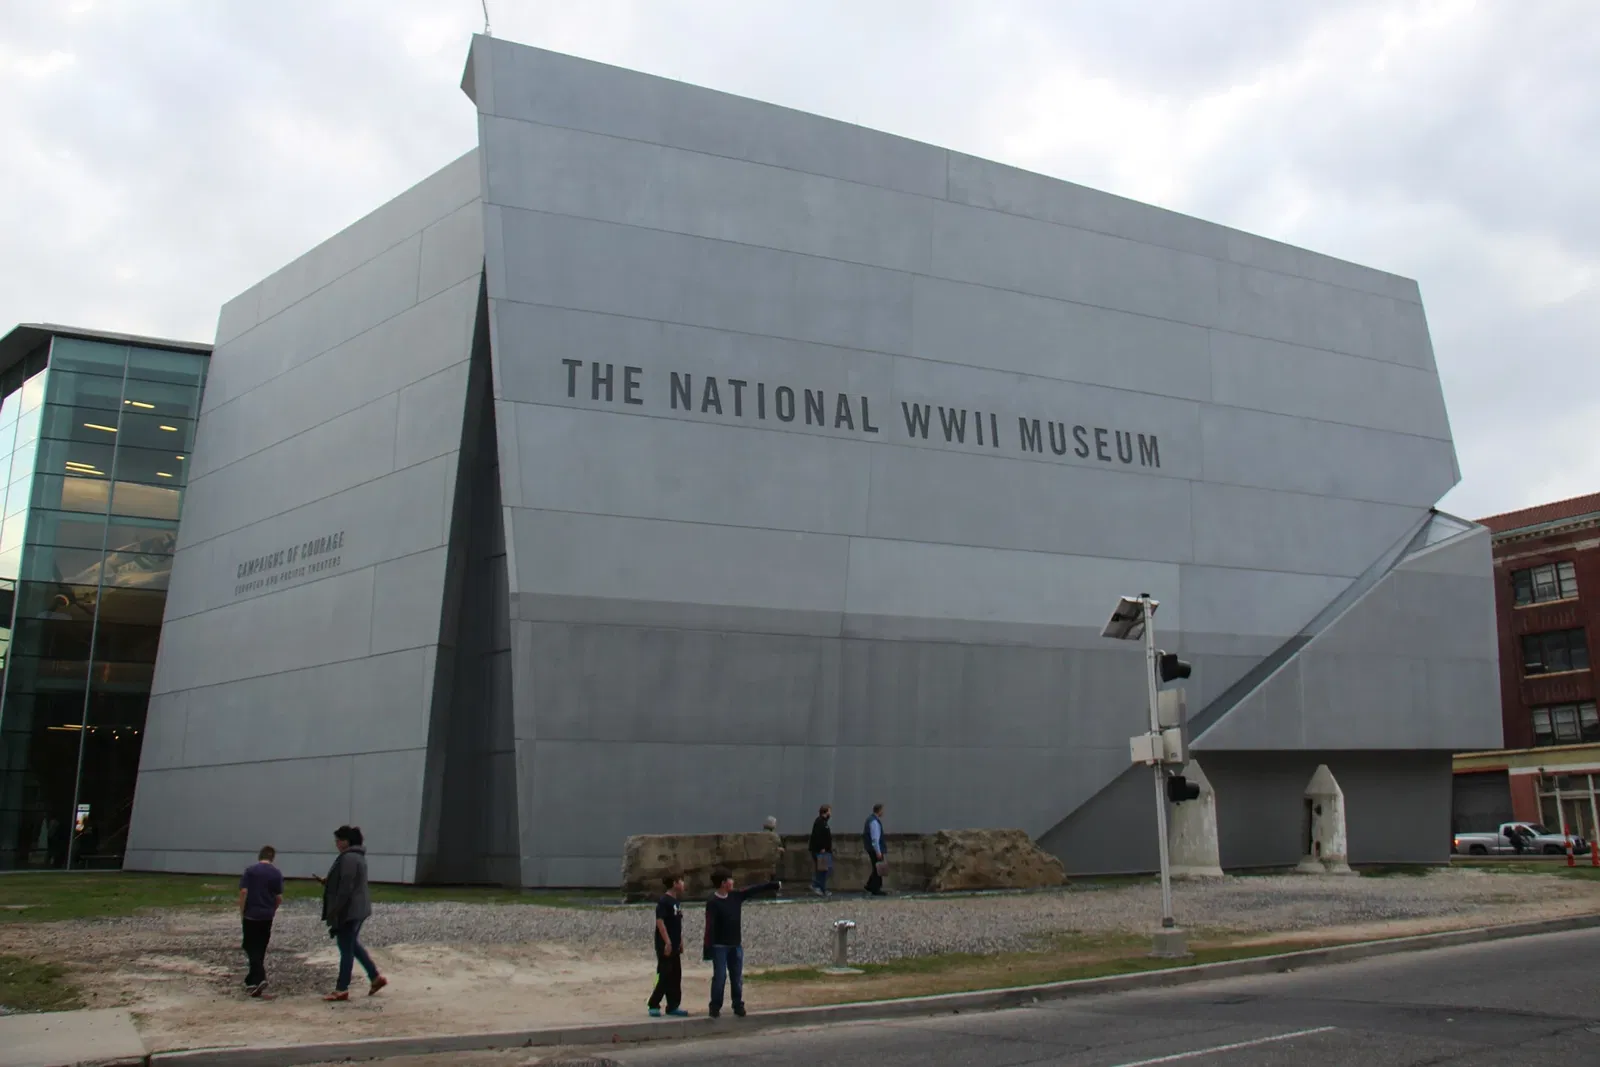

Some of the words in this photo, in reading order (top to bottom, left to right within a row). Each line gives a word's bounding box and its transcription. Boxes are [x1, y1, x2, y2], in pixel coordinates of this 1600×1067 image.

[561, 358, 643, 405] THE
[670, 372, 879, 433] NATIONAL
[901, 401, 999, 448] WWII
[1018, 417, 1161, 468] MUSEUM
[237, 550, 284, 579] CAMPAIGNS
[287, 545, 299, 564] OF
[301, 531, 344, 560] COURAGE
